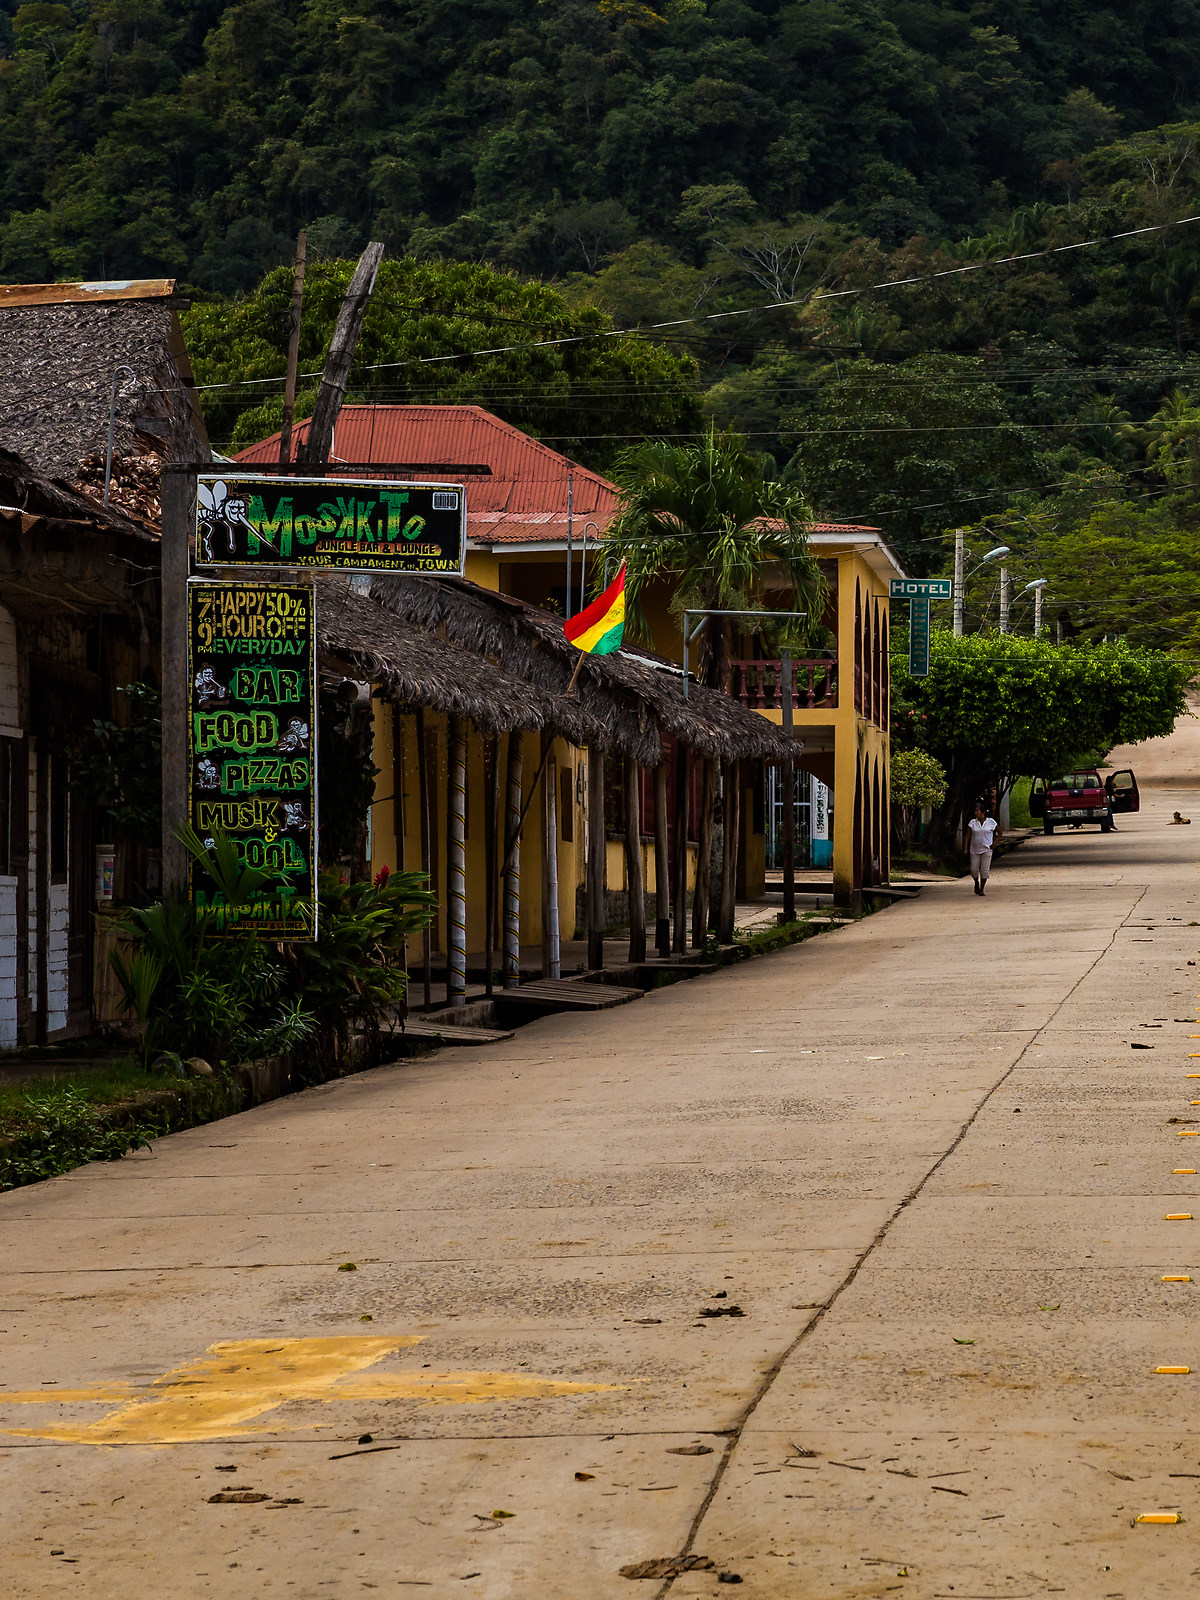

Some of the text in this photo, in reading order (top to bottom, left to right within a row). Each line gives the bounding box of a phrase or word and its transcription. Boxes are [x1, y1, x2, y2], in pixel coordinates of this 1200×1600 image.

[318, 541, 436, 555] JUNGLE BAR & LOUNGE
[298, 555, 332, 566] YOUR
[417, 558, 459, 571] TOWN
[892, 582, 948, 594] HOTEL
[197, 597, 212, 618] 7
[212, 591, 306, 617] HAPPY 50%
[197, 622, 212, 646] 9
[212, 614, 306, 638] HOUR OFF
[197, 645, 213, 653] PM
[212, 638, 306, 655] EVERYDAY
[236, 668, 300, 704] BAR
[200, 713, 275, 749] FOOD
[226, 759, 308, 790] PIZZAS
[200, 799, 279, 830] MUSIK
[264, 827, 277, 842] &
[277, 921, 303, 930] LUNGE
